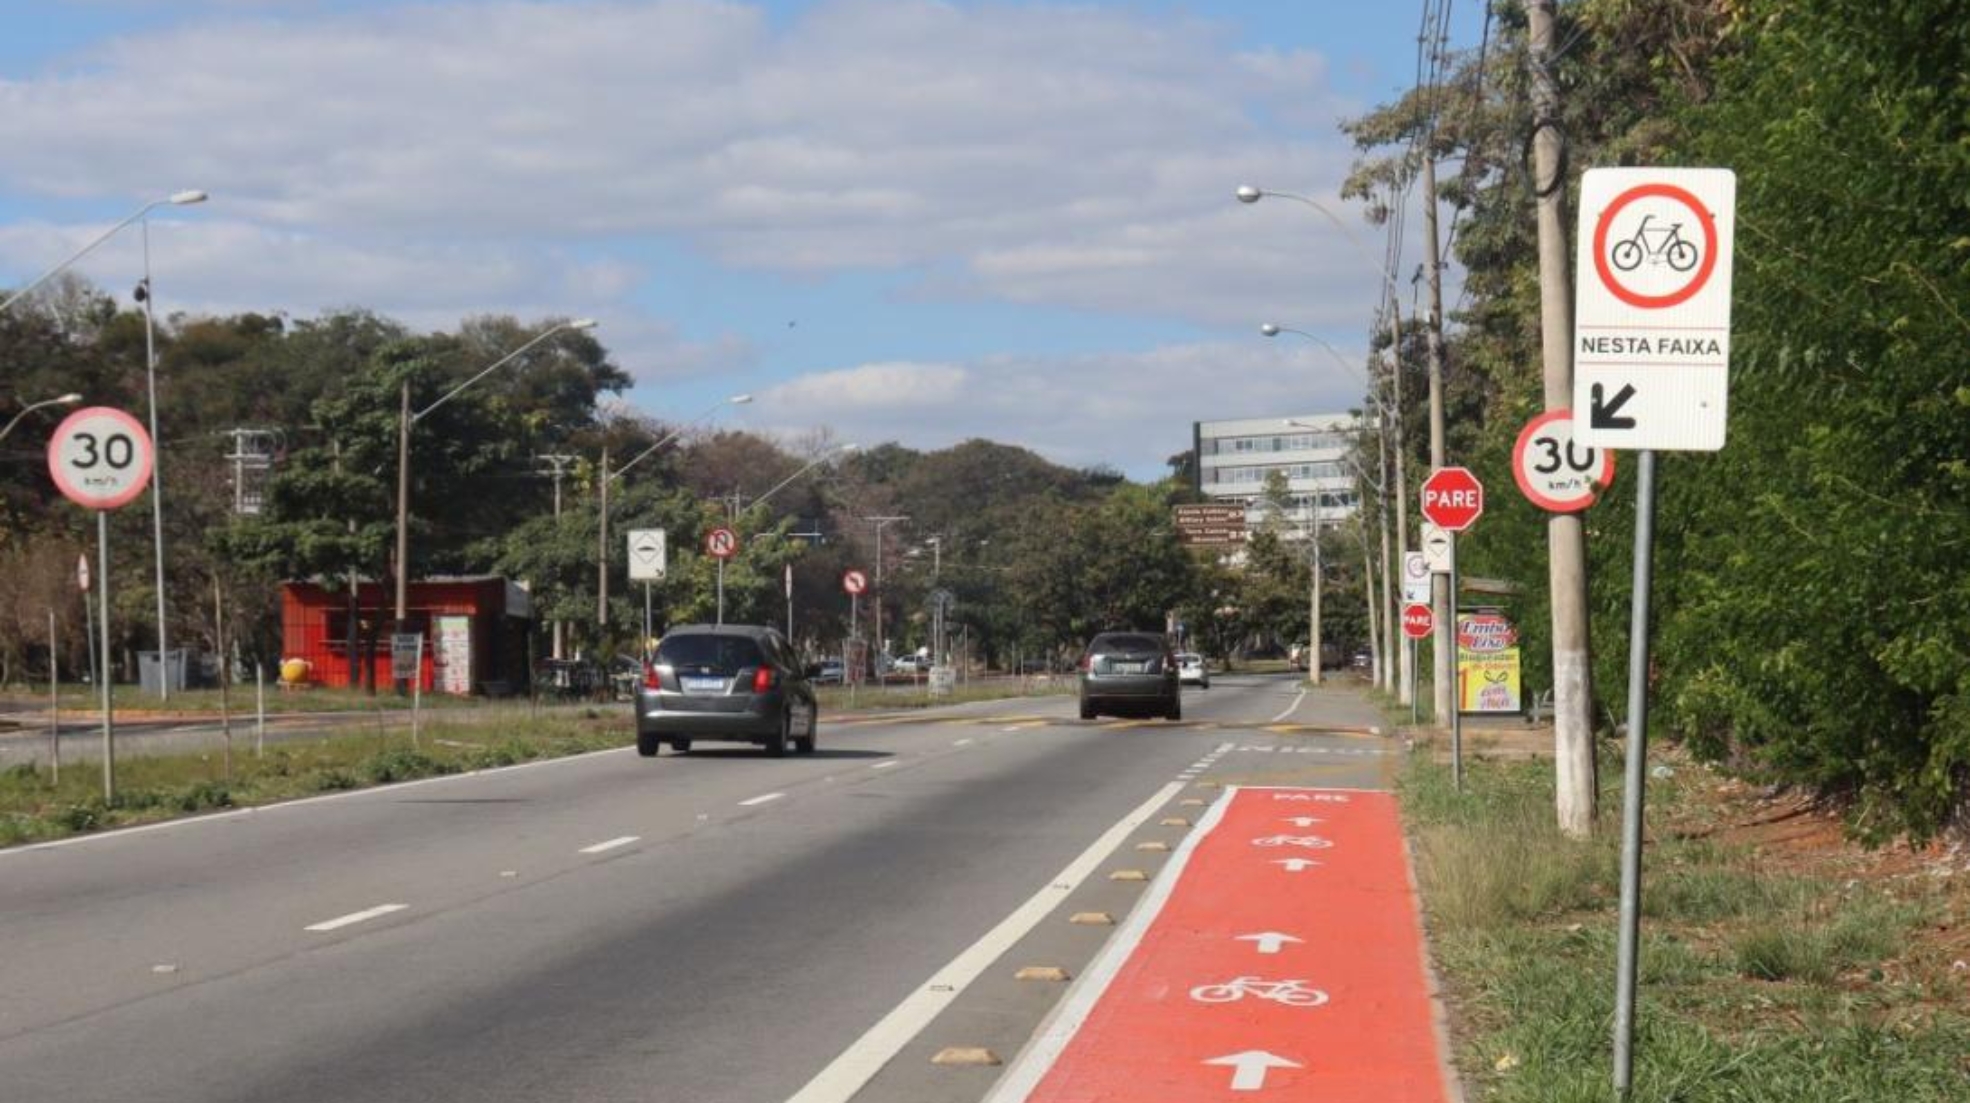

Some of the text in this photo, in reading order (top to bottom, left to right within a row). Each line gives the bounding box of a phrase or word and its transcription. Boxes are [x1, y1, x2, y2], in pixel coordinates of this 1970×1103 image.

[1582, 337, 1721, 356] NESTA FAIXA
[71, 433, 134, 469] 30
[1534, 437, 1595, 474] 30
[1548, 477, 1581, 490] km/h
[1425, 489, 1477, 508] PARE
[1405, 615, 1430, 627] PARE
[1273, 793, 1351, 802] PARE
